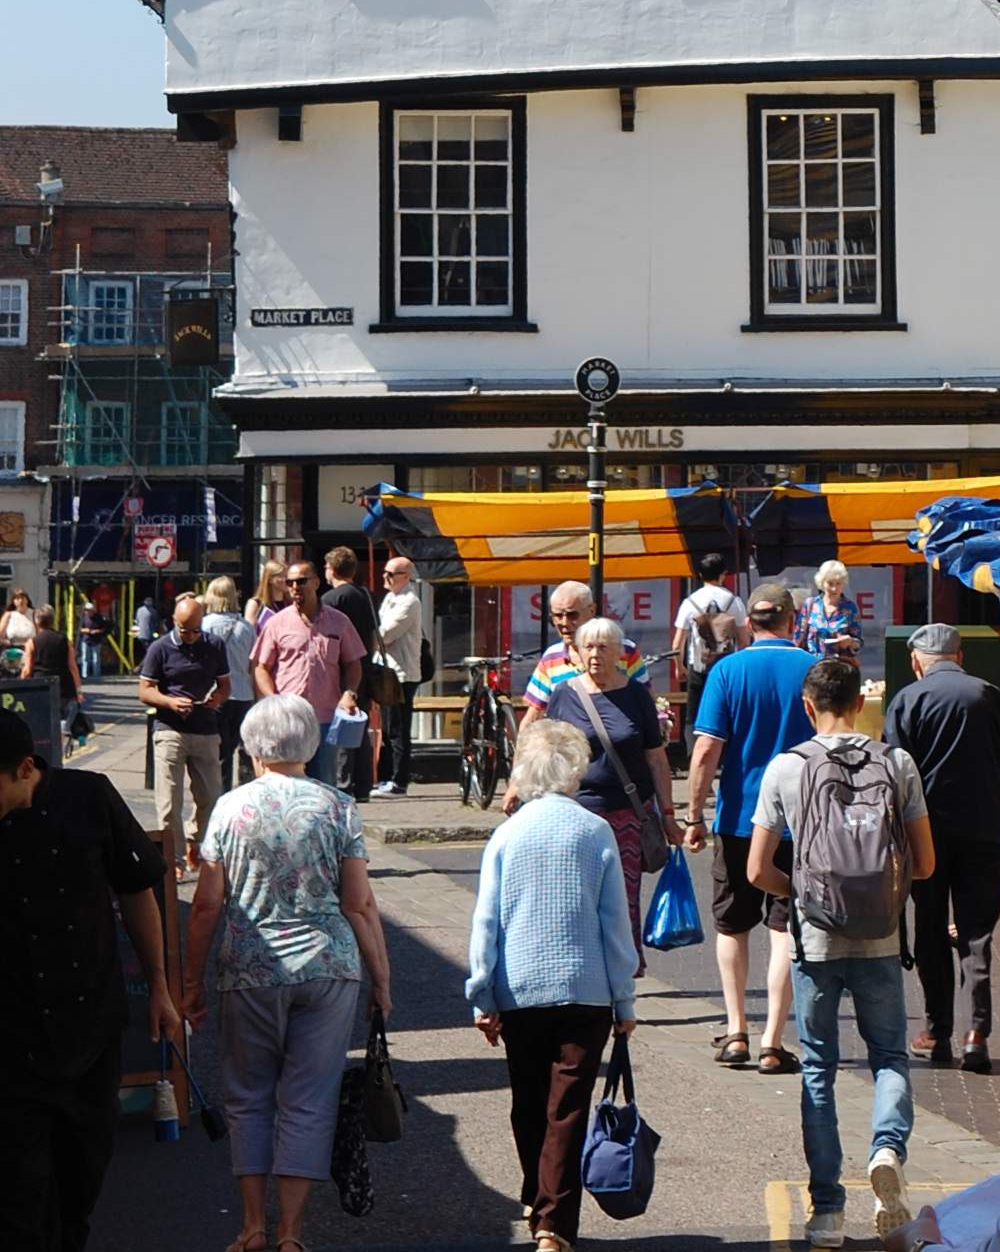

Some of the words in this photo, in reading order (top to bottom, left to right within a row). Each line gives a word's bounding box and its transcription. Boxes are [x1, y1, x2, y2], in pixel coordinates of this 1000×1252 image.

[254, 310, 306, 324] MARKET
[311, 310, 350, 324] PLACE
[174, 327, 192, 342] JACK
[191, 324, 212, 341] WILLS
[581, 360, 616, 376] MARKET
[585, 389, 611, 400] PLACE
[549, 429, 607, 450] JAC
[616, 429, 684, 448] WILLS
[530, 592, 652, 620] SLE
